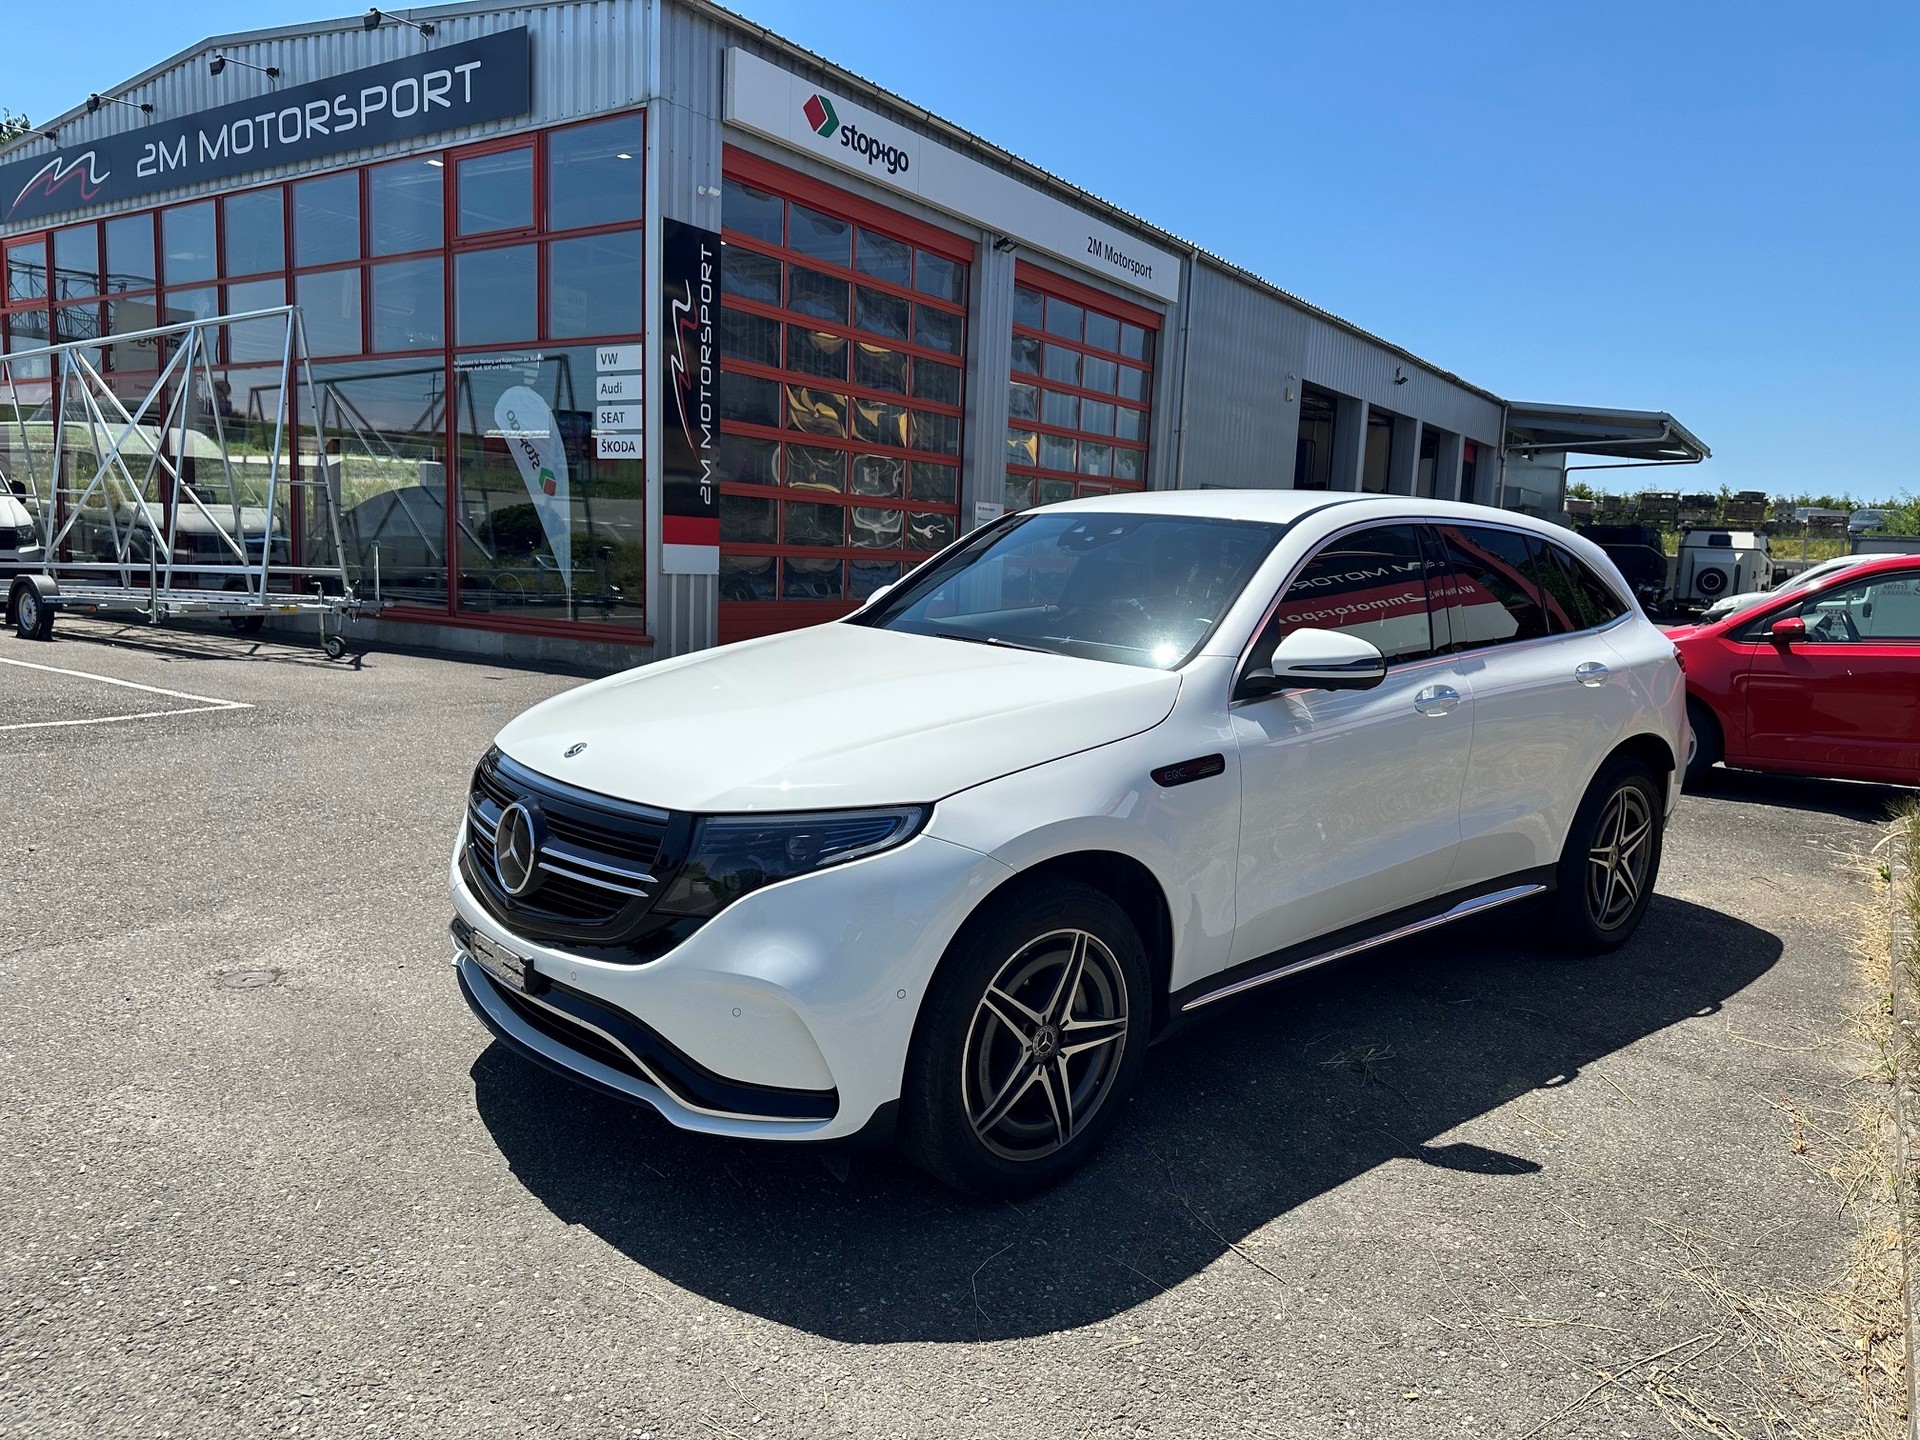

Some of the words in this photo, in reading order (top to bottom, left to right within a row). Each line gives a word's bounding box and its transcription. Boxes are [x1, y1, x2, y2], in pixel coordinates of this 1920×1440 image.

[136, 135, 188, 179] 2M
[199, 60, 482, 164] MOTORSPORT
[841, 123, 909, 174] stop+go
[1087, 236, 1102, 258] 2M
[1104, 245, 1153, 280] Motorsport
[600, 352, 619, 366] VW
[700, 243, 713, 450] MOTORSPORT
[601, 382, 623, 394] Audi
[601, 411, 625, 424] SEAT
[601, 438, 636, 453] ŠKODA
[700, 460, 712, 505] 2M
[1164, 767, 1187, 781] EQC
